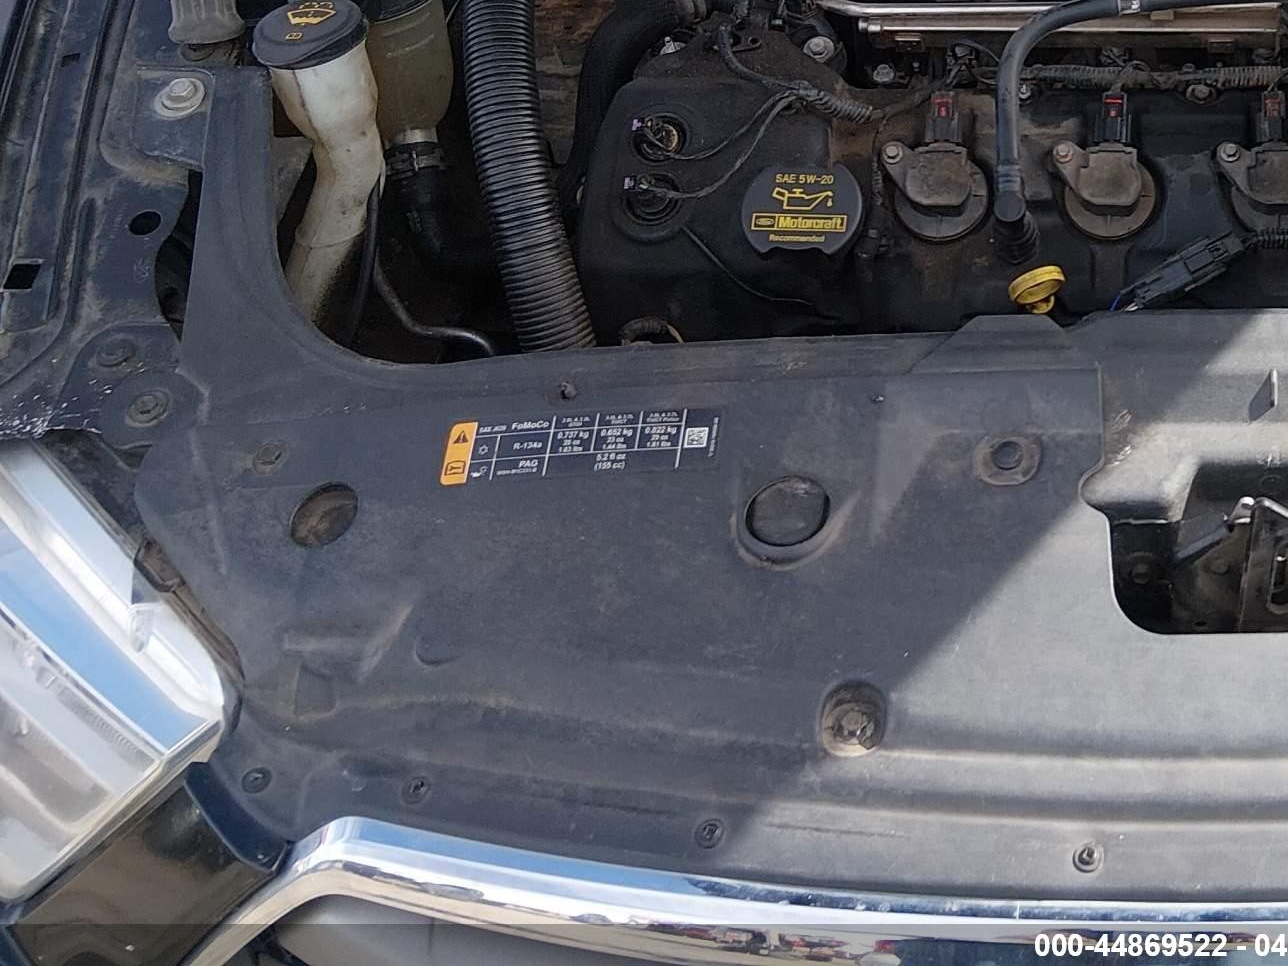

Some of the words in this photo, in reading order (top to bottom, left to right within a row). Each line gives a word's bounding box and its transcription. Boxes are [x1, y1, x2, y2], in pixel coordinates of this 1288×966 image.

[775, 174, 796, 183] SAE
[799, 174, 834, 185] 5W-20
[778, 216, 842, 230] Motorcraft
[769, 233, 825, 243] Recommended
[512, 420, 550, 430] FoMoCo
[623, 428, 633, 437] kg
[667, 426, 678, 435] kg
[579, 431, 590, 440] kg
[513, 441, 543, 450] R-134a
[518, 459, 539, 468] PAG
[612, 461, 626, 470] cc)
